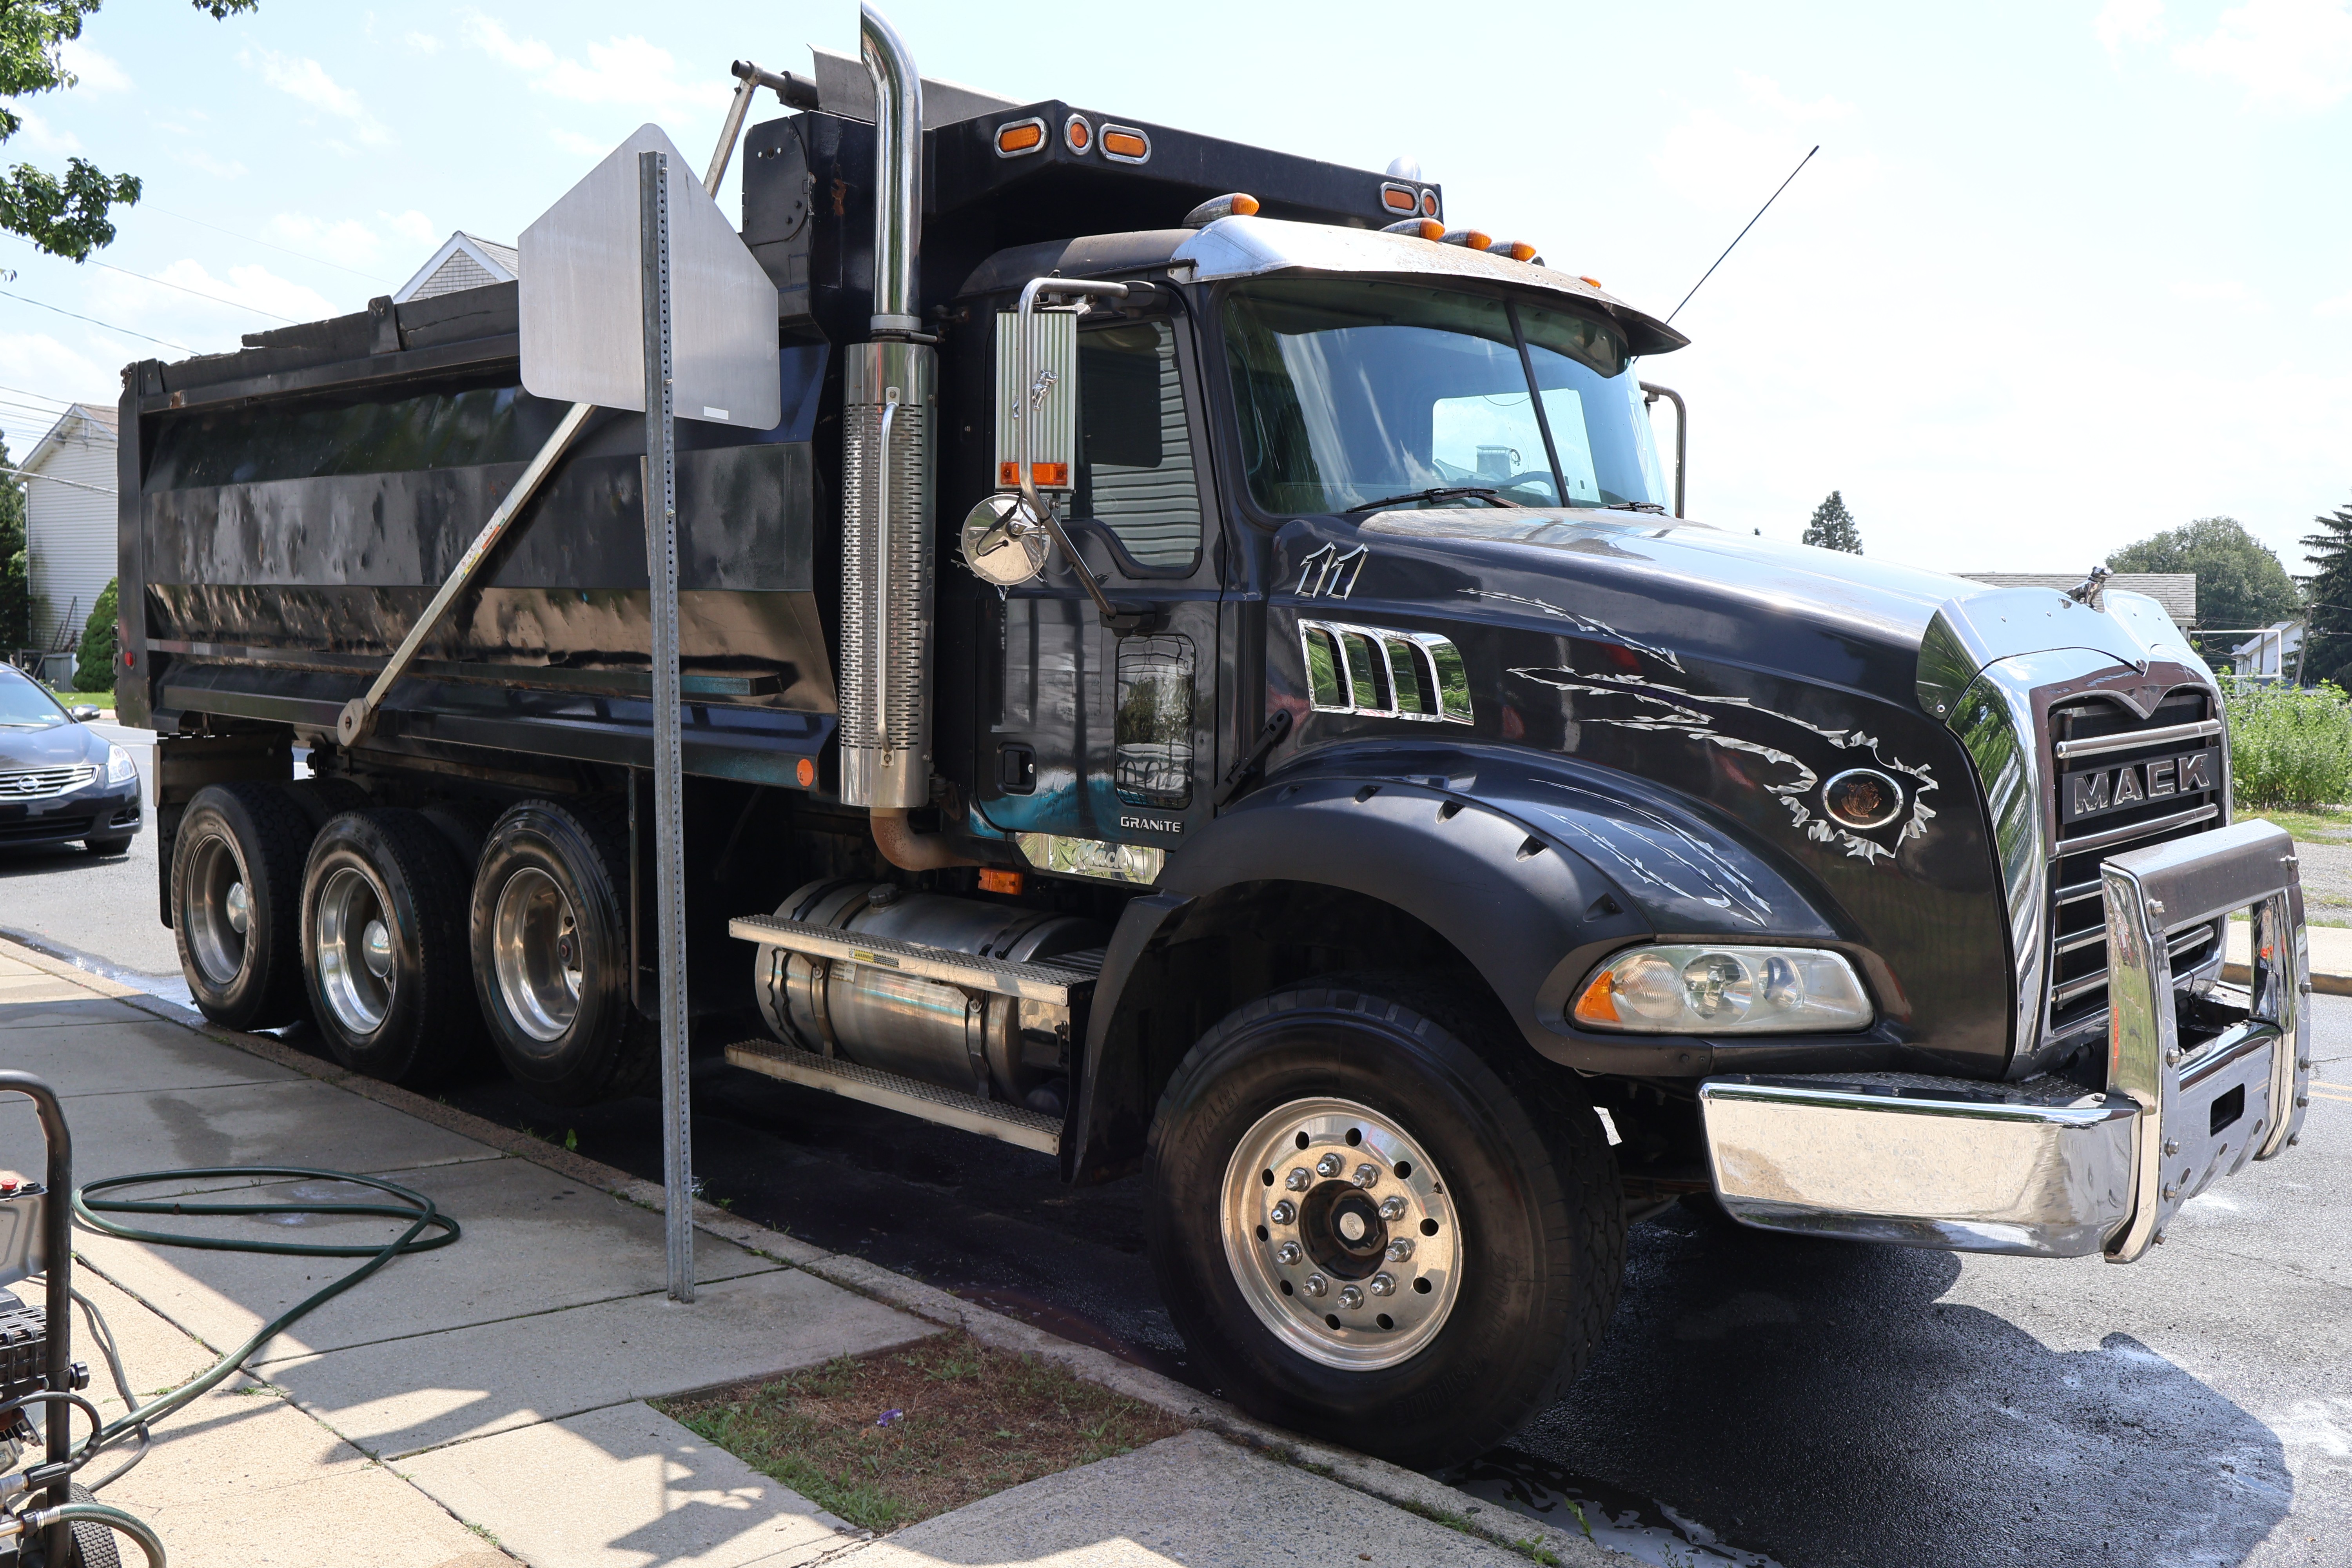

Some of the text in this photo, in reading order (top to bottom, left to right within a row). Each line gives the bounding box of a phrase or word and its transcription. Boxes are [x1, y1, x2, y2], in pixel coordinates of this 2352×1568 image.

[1294, 541, 1369, 601] 11
[2074, 753, 2210, 815] MACK
[1120, 816, 1181, 833] GRANITE
[1073, 842, 1130, 870] Mack
[1178, 1082, 1240, 1194] M748
[1392, 1246, 1518, 1425] BRIDGESTONE
